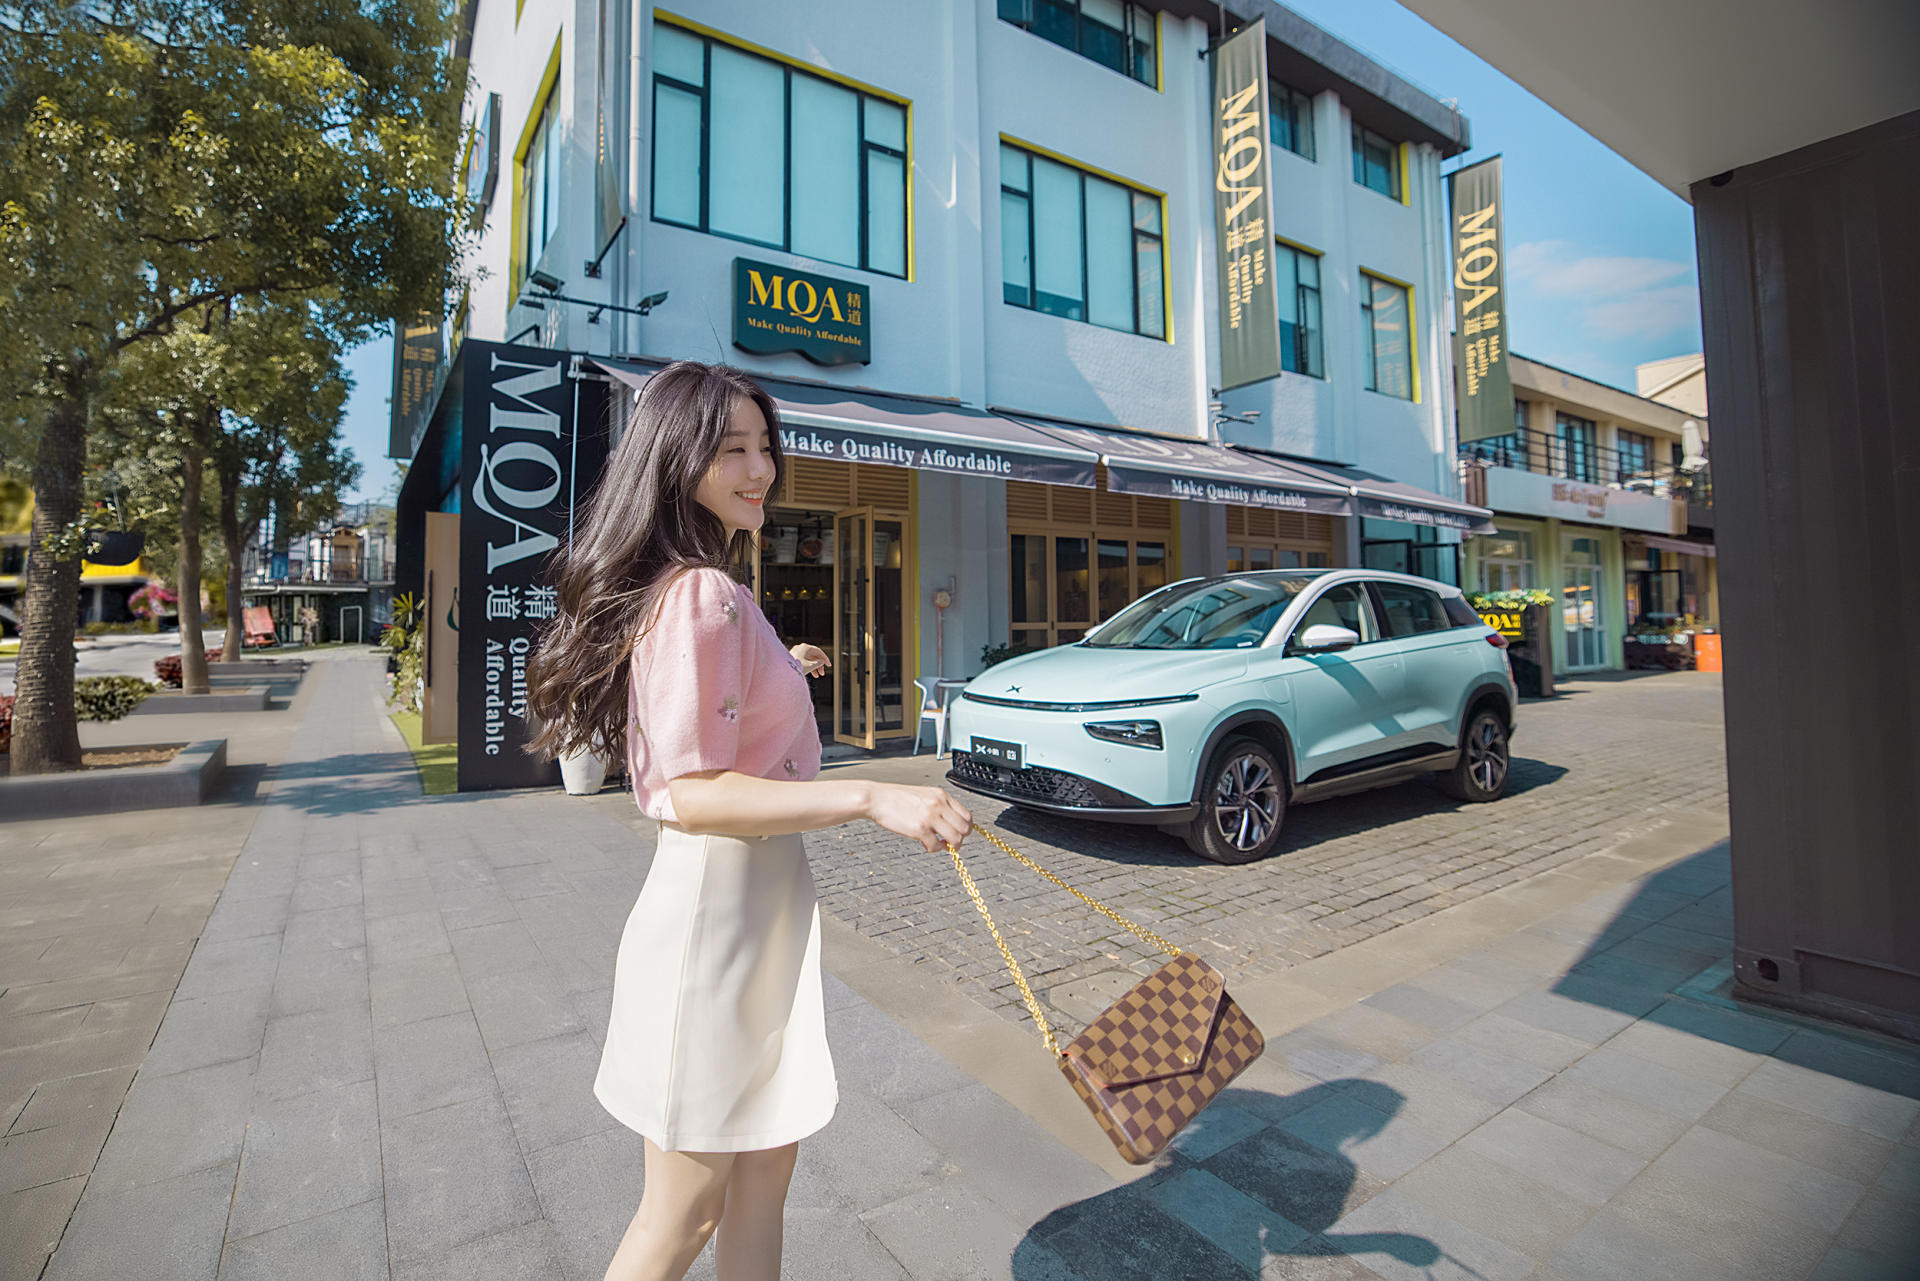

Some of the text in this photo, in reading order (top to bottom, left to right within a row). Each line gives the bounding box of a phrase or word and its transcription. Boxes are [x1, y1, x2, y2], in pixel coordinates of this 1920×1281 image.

[1216, 78, 1263, 226] MQA
[1240, 254, 1253, 304] Quality
[1253, 248, 1266, 286] Make
[1454, 202, 1498, 316] MQA
[747, 269, 845, 323] MQA
[1228, 261, 1241, 329] Affordable
[747, 317, 862, 346] Make Quality Affordable
[472, 352, 562, 575] MQA
[780, 430, 1012, 473] Make Quality Affordable
[1171, 479, 1307, 507] Make Quality Affordable
[486, 584, 558, 621] 精道
[485, 638, 505, 756] Affordable
[508, 637, 531, 719] Quality
